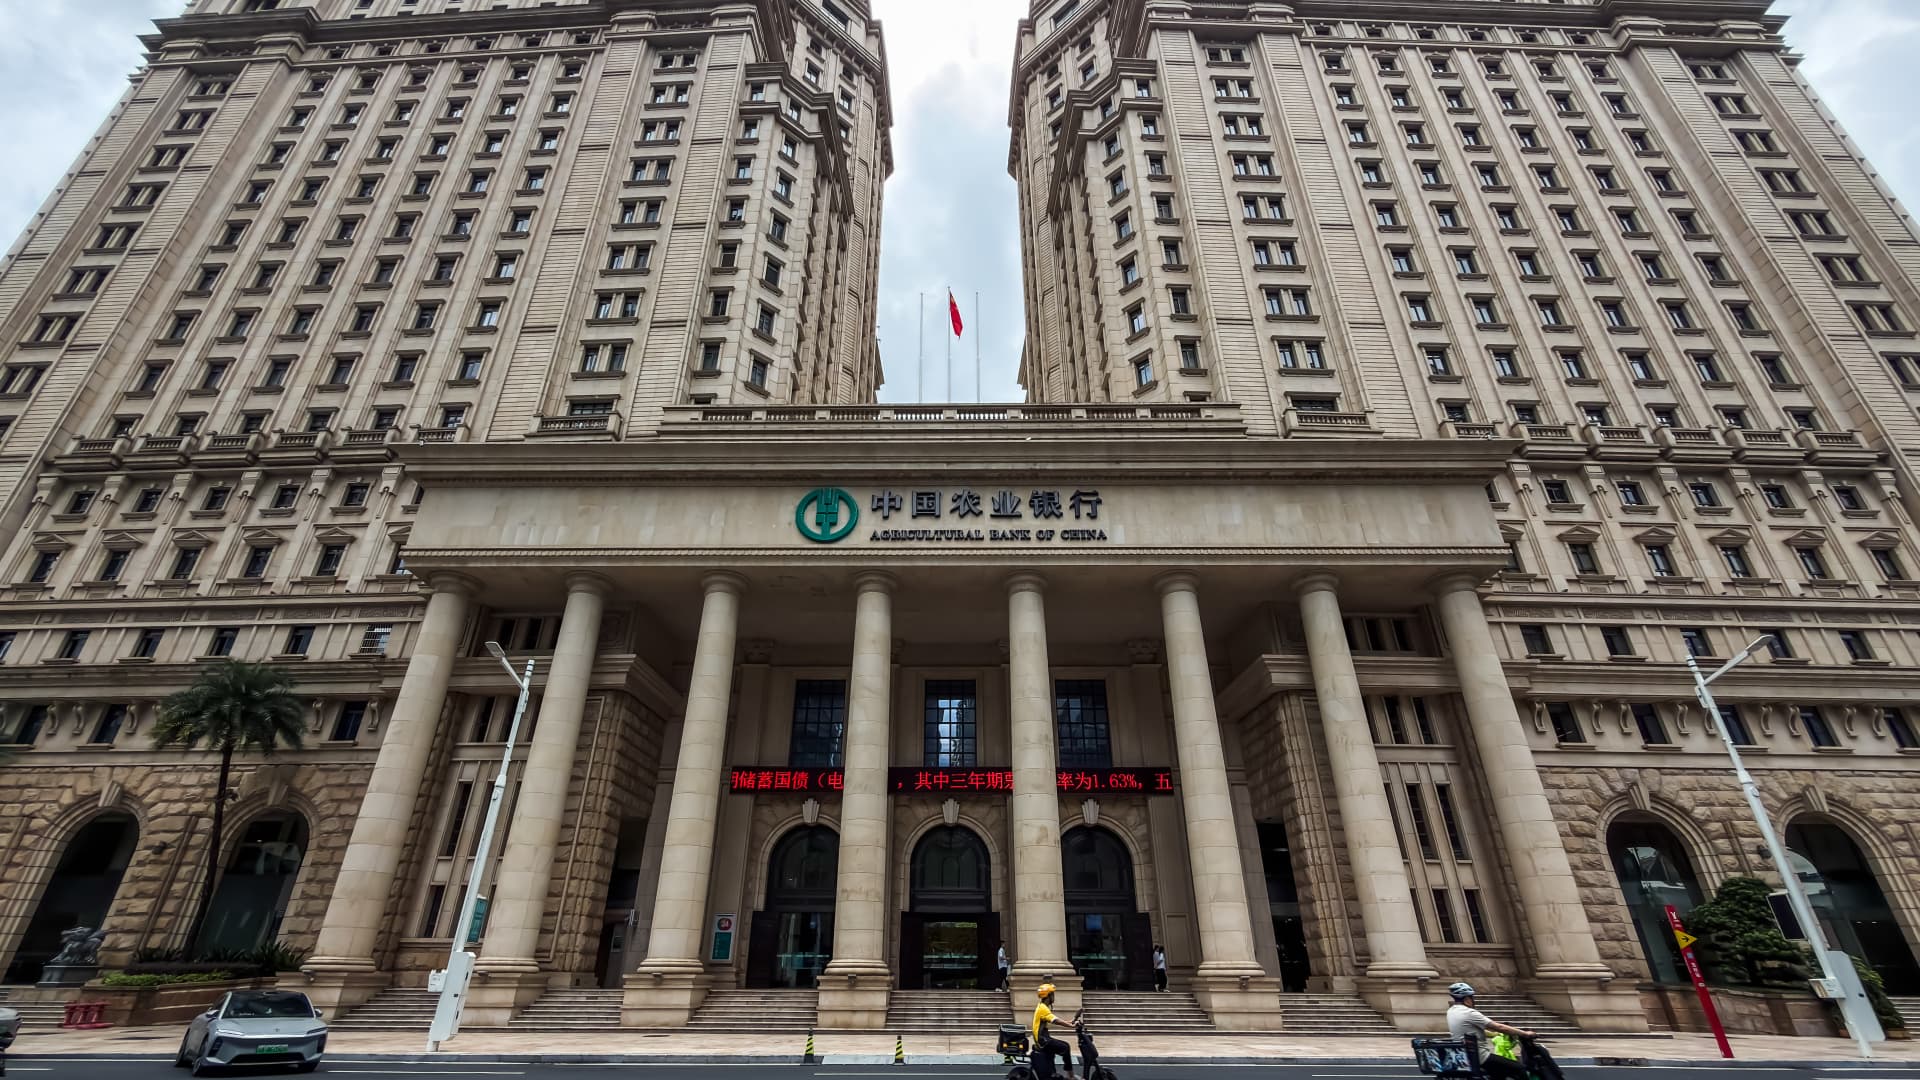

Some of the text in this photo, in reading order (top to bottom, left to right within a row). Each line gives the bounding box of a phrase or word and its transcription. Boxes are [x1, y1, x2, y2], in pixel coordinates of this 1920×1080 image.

[871, 489, 1102, 519] 中国农业银行
[870, 529, 1107, 541] AGRICULTURAL BANK OF CHINA
